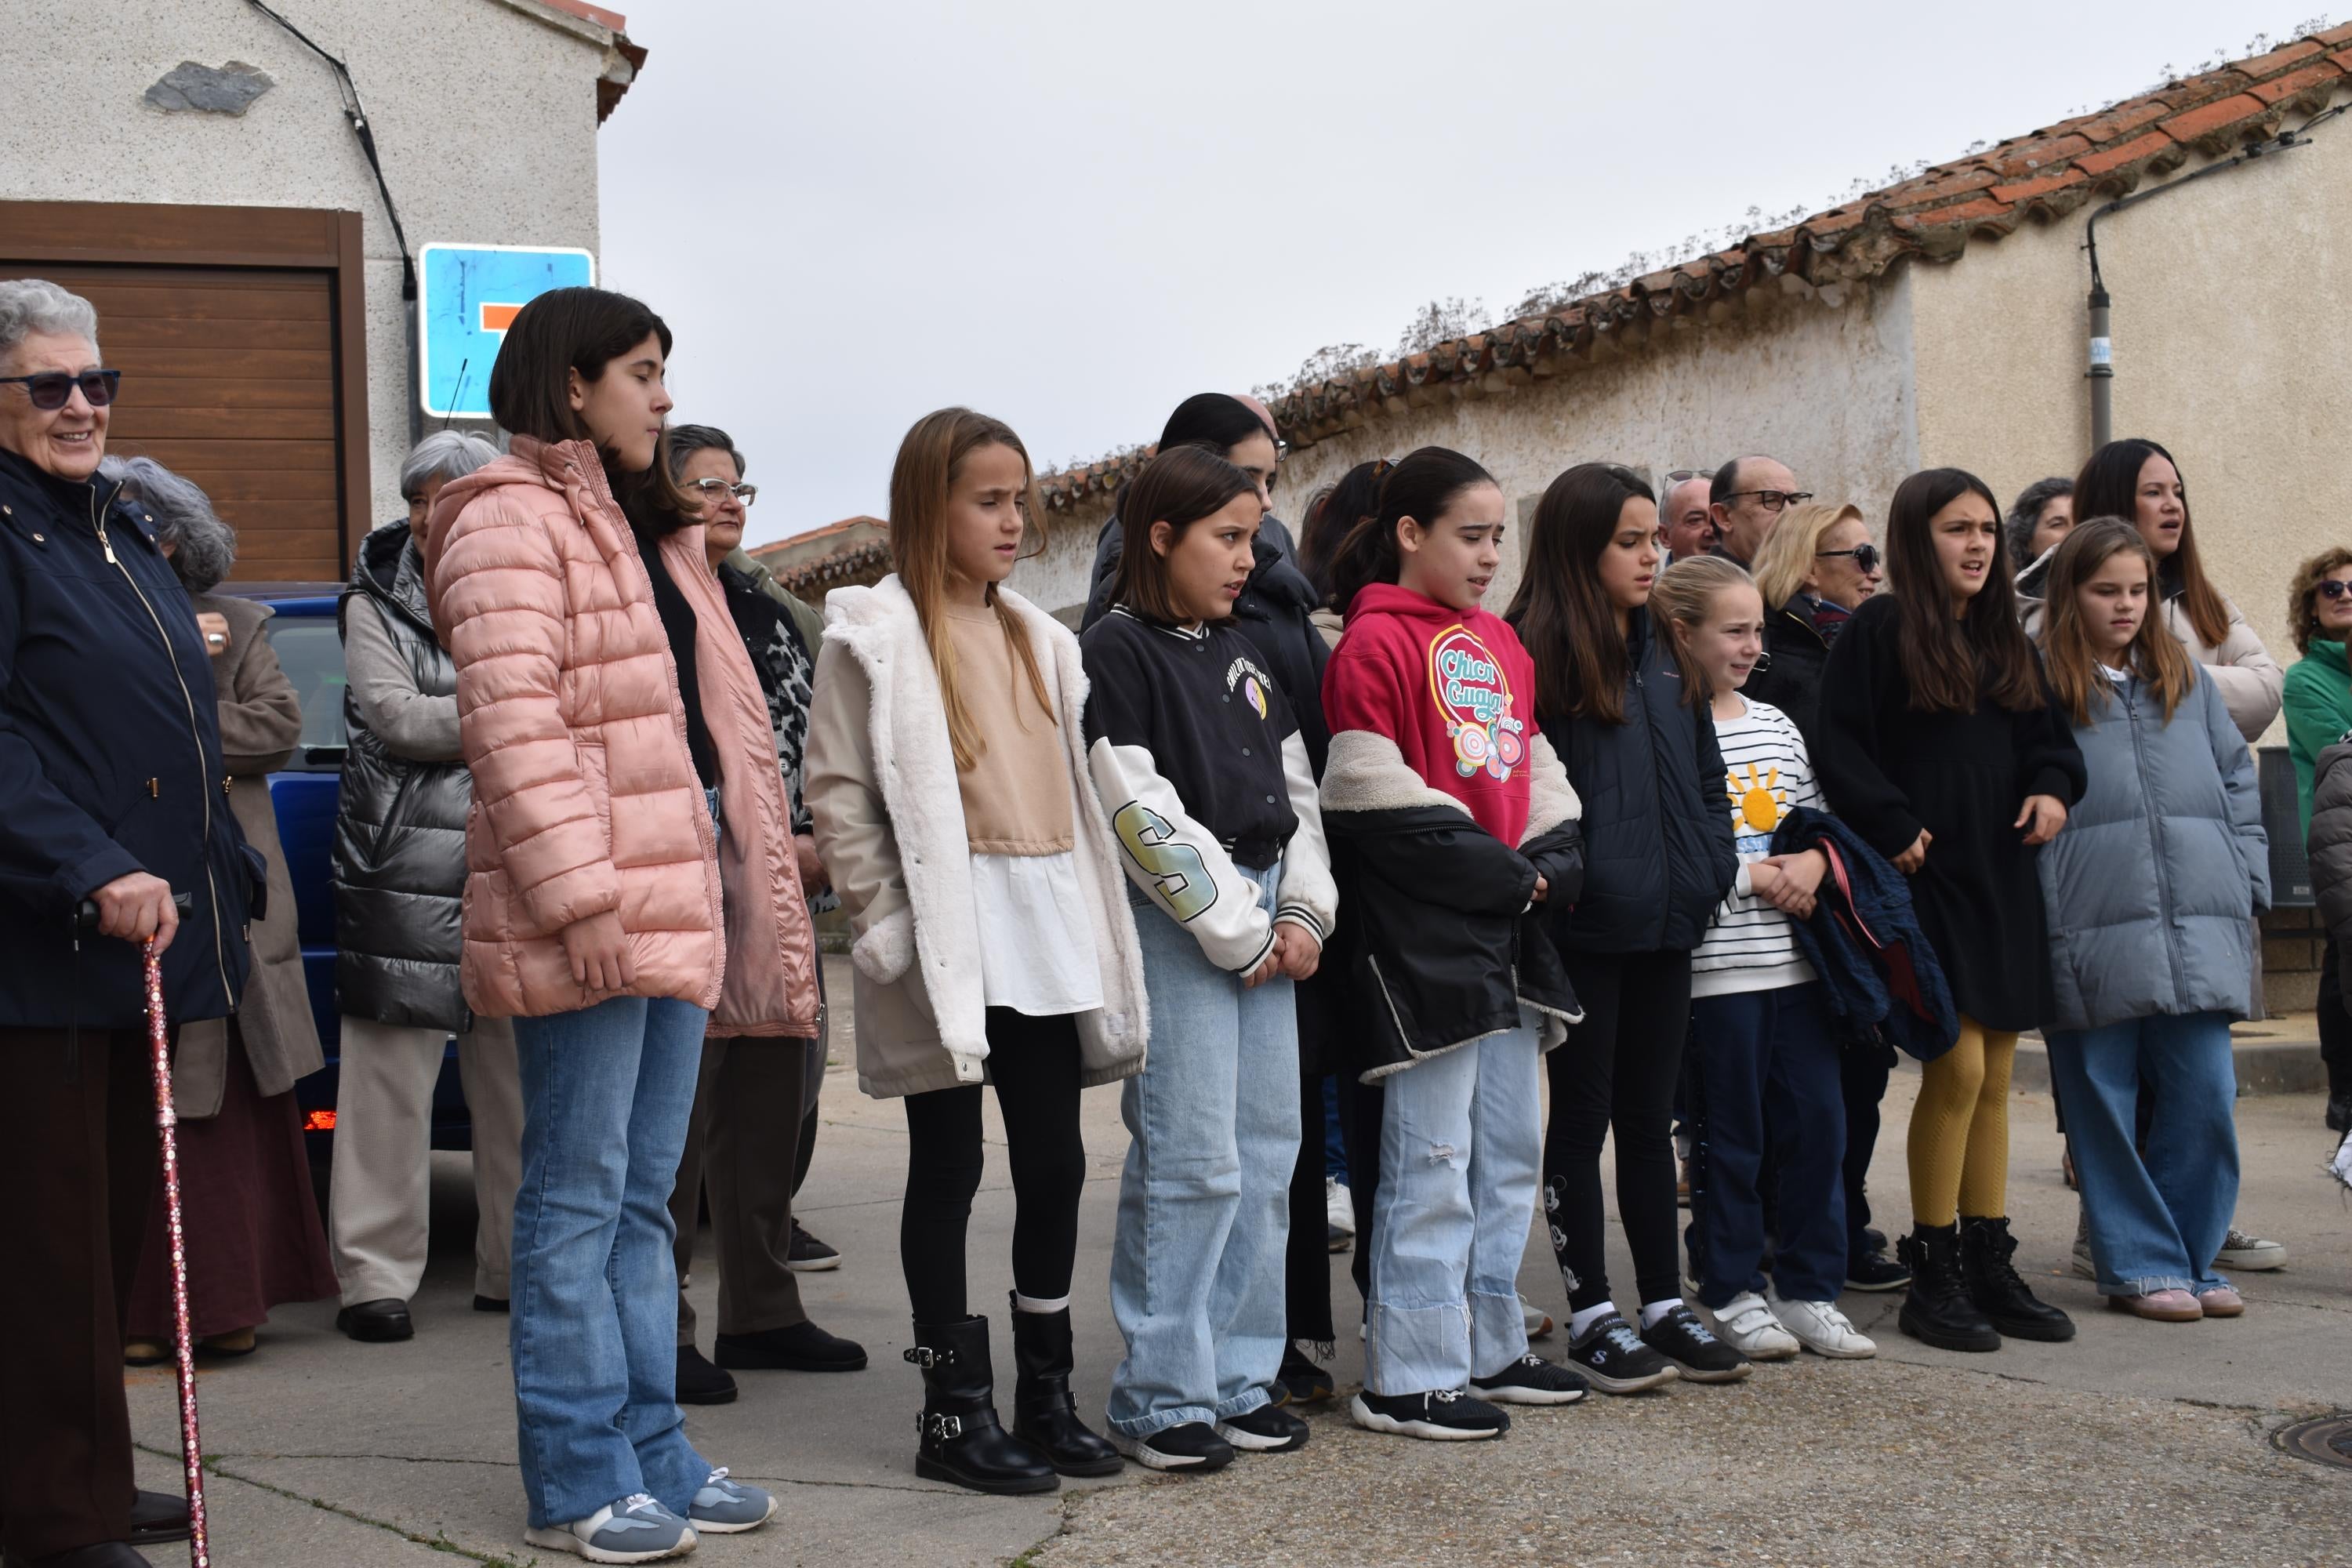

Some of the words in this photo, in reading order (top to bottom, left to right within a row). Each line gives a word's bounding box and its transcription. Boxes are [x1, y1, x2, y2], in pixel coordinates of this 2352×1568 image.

[1440, 649, 1495, 685] Chica
[1112, 800, 1218, 924] S
[1591, 1350, 1606, 1364] S
